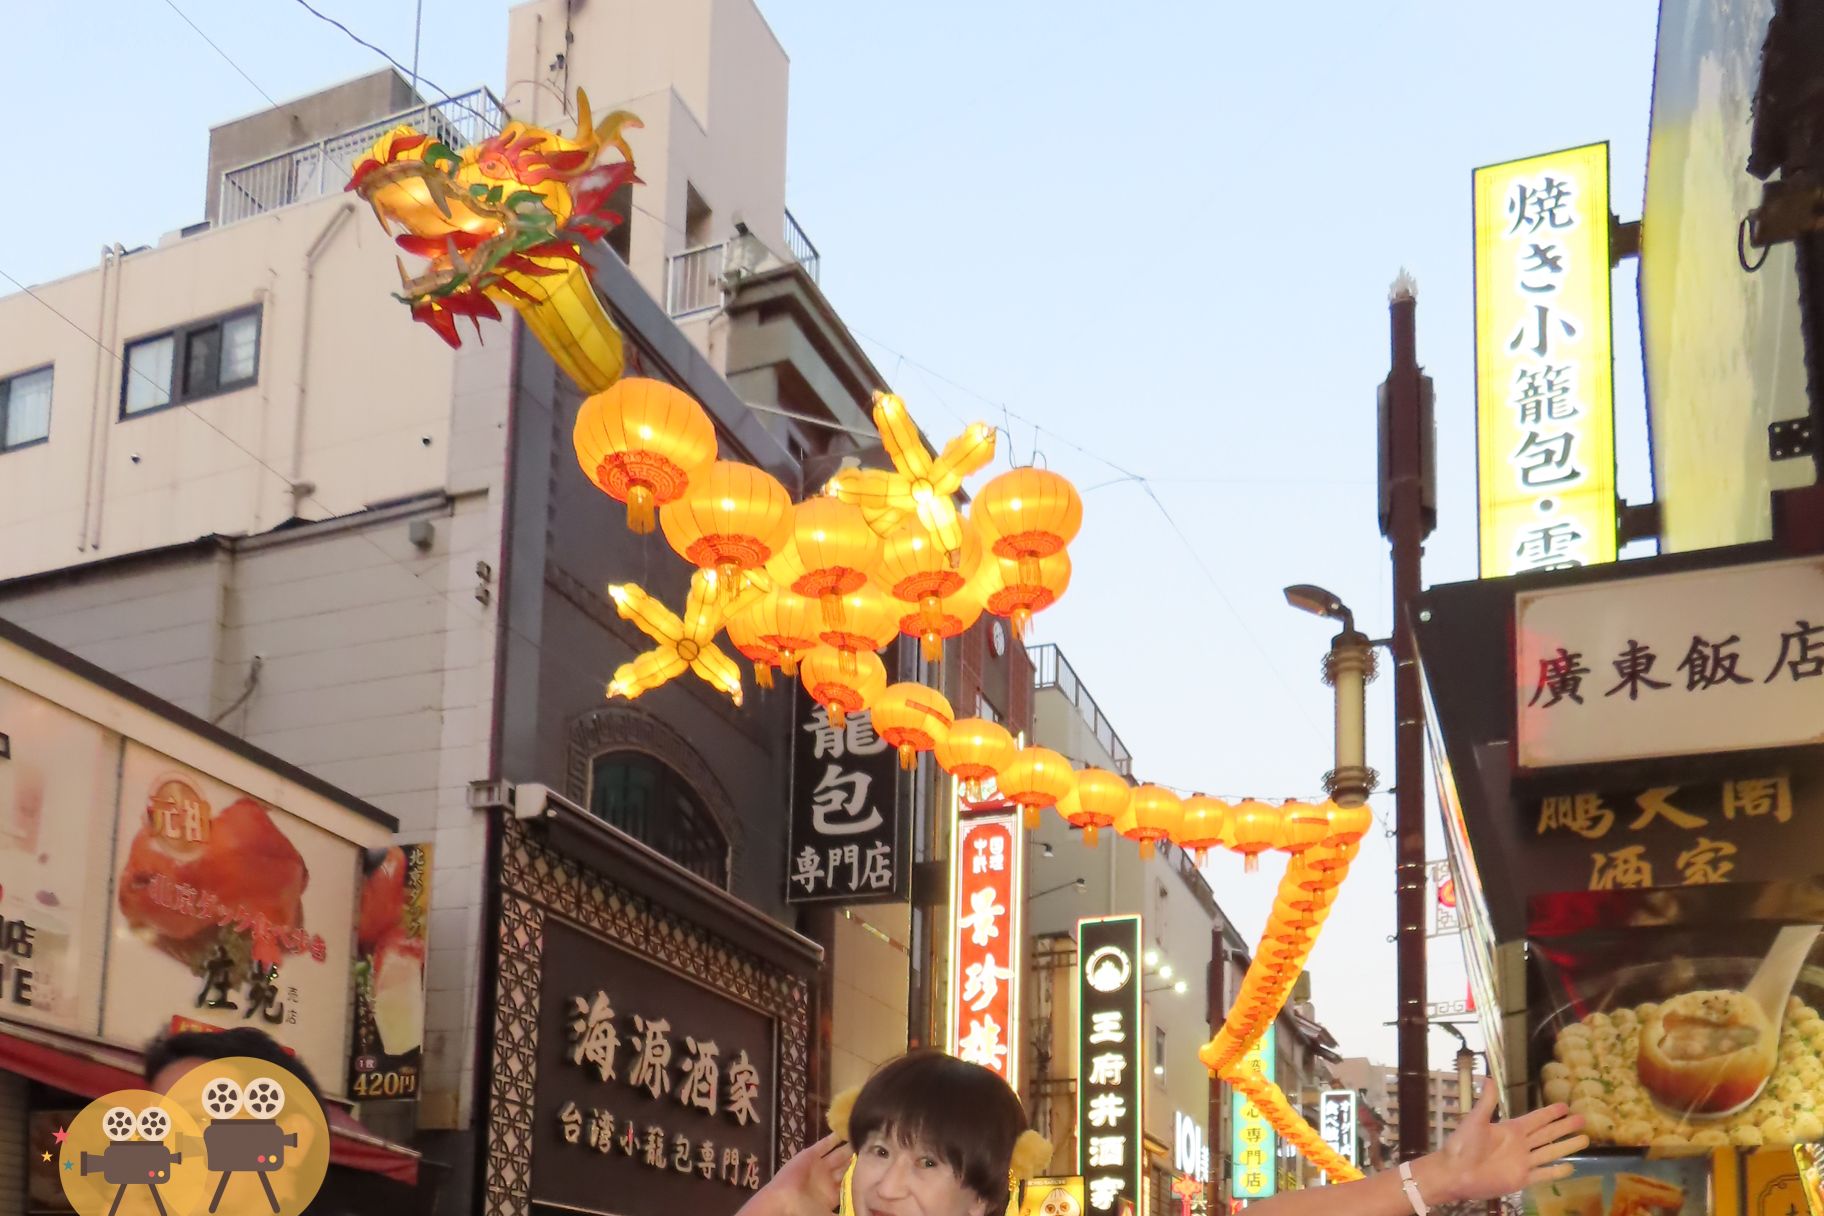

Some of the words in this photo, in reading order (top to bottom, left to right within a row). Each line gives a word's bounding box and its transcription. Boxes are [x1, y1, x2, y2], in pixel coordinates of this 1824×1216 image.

[1527, 620, 1824, 709] 廣東飯店
[791, 841, 893, 893] 専門店
[0, 915, 36, 958] 店
[570, 990, 760, 1127] 海源酒家
[560, 1102, 760, 1190] 台湾小籠包専門店
